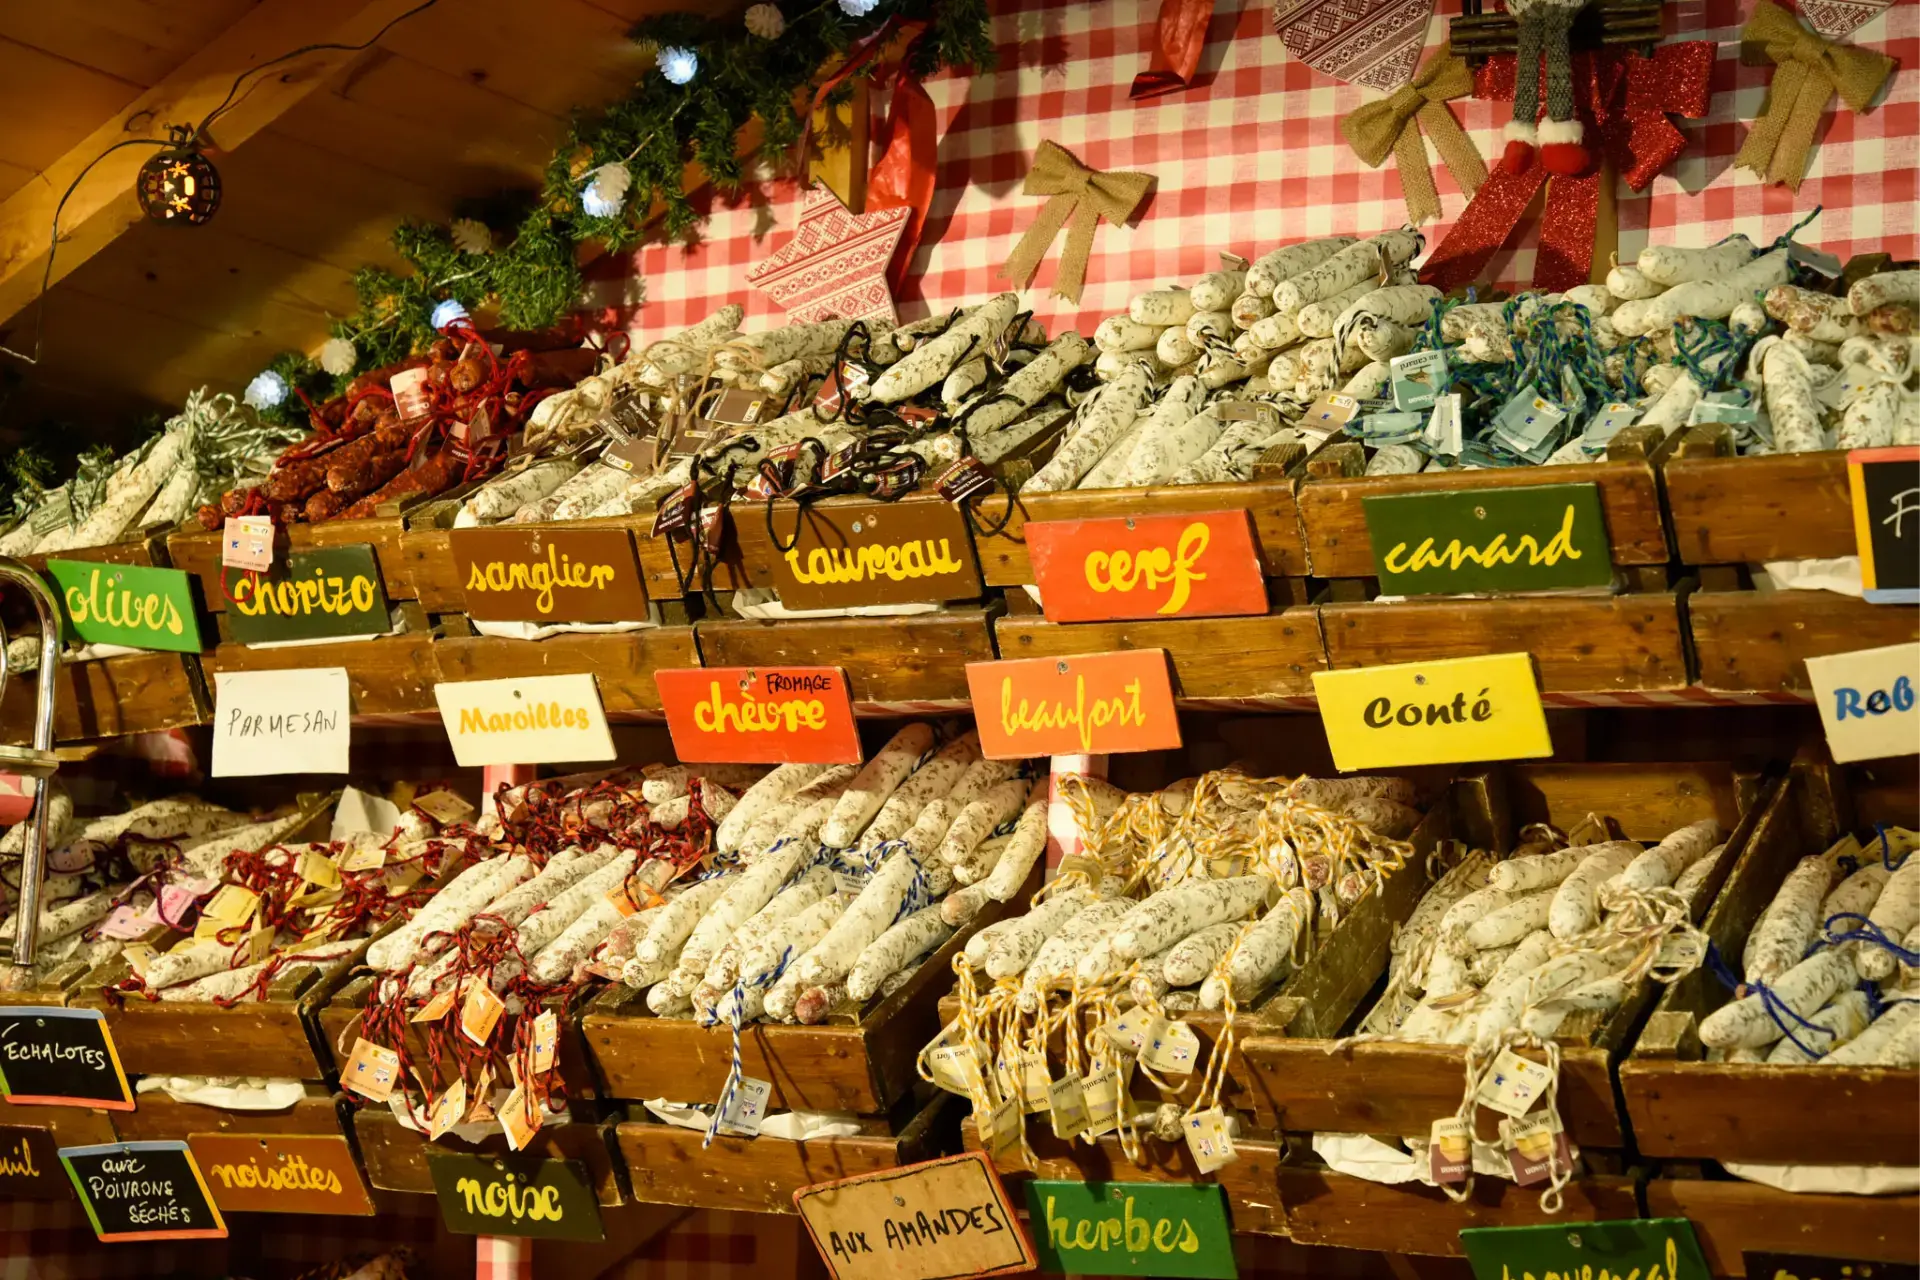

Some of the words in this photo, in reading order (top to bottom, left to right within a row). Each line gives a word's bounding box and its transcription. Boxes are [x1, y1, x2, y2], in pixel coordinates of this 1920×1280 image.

[784, 534, 962, 585] taureau
[1383, 504, 1581, 574] canard
[234, 567, 376, 616] chorizo
[466, 543, 615, 613] sanglier
[1084, 522, 1210, 614] cerf
[65, 569, 184, 635] olives
[694, 681, 828, 733] chèvre
[766, 672, 832, 695] FROMAGE
[1363, 687, 1493, 729] Conté
[227, 707, 338, 737] PARMESAN
[459, 701, 591, 735] Maroilles
[1001, 674, 1146, 751] beaufort
[102, 1158, 146, 1174] aux
[211, 1154, 342, 1194] noisettes
[456, 1172, 563, 1222] noix
[829, 1230, 872, 1265] AUX
[885, 1201, 1004, 1252] AMANDES
[1046, 1195, 1199, 1254] herbes
